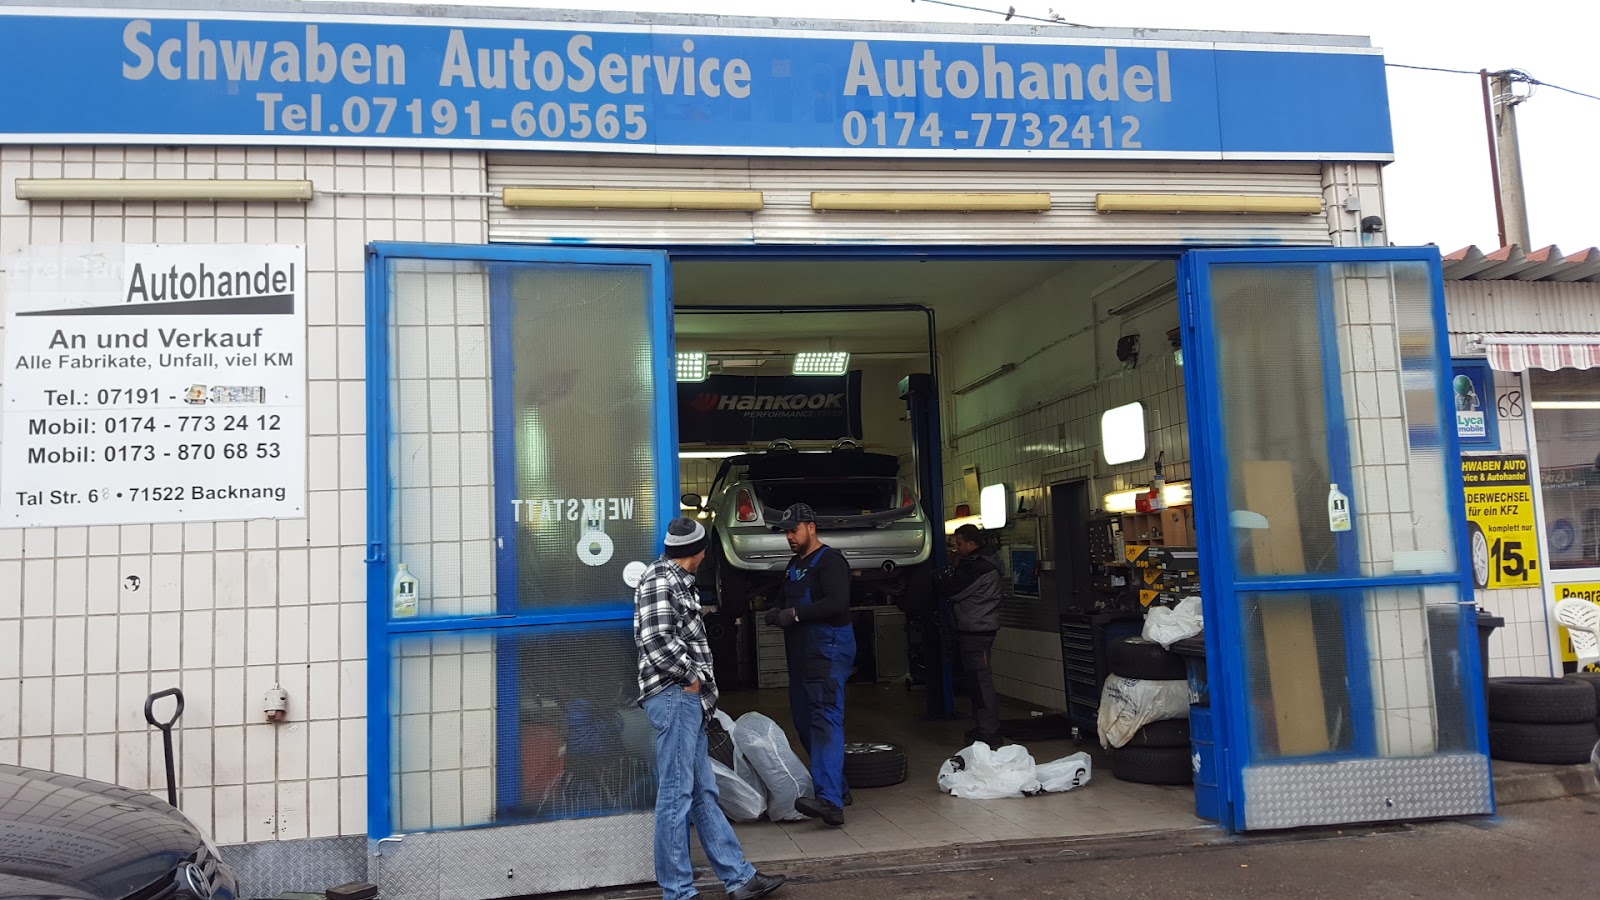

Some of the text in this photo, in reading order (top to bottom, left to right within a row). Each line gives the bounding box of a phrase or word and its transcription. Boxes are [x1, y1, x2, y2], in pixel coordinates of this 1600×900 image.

[122, 19, 751, 99] Schwaben AutoService
[843, 41, 1172, 102] Autohandel
[126, 262, 295, 302] Autohandel
[49, 327, 263, 349] An und Verkauf
[15, 352, 294, 370] Alle Fabrikate, Unfall, viel KM
[44, 389, 88, 406] Tel.:
[97, 388, 160, 405] 07191
[1497, 390, 1523, 418] 68
[743, 410, 815, 418] PERFORMANCE
[1457, 415, 1483, 427] Lyca
[28, 418, 96, 435] Mobil:
[104, 417, 156, 433] 0174
[178, 416, 216, 432] 773
[223, 415, 249, 431] 24
[257, 414, 281, 431] 12
[28, 447, 96, 464] Mobil:
[104, 445, 156, 462] 0173
[178, 444, 216, 461] 870
[223, 443, 248, 460] 68
[256, 442, 281, 459] 53
[1462, 460, 1526, 472] HWABEN AUTO
[1463, 474, 1478, 482] vice
[1487, 472, 1526, 481] Autohandel
[16, 491, 43, 505] Tal
[50, 489, 81, 505] Str.
[129, 487, 185, 502] 71522
[192, 485, 286, 501] Backnang
[1467, 492, 1530, 504] DERWECHSEL
[1468, 505, 1519, 517] für ein KFZ
[1488, 524, 1533, 533] komplett nur
